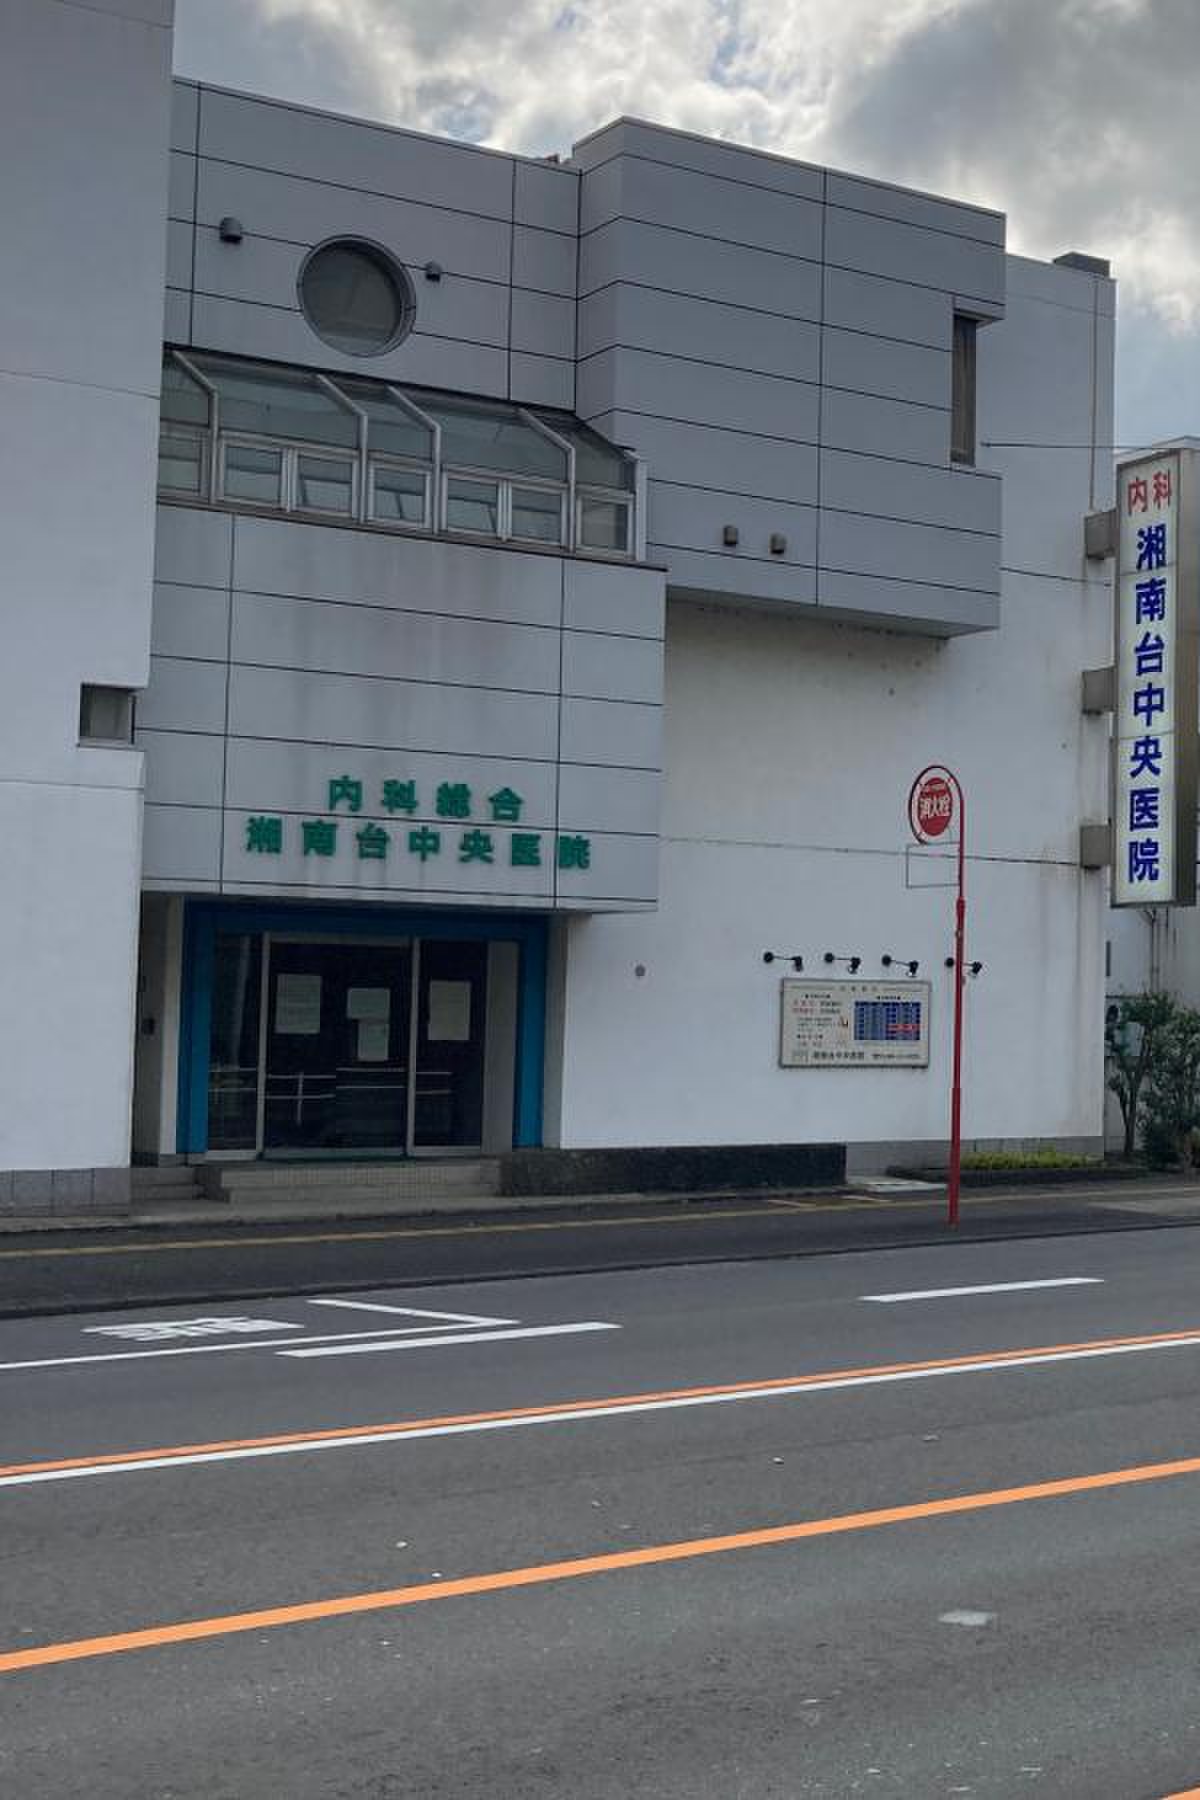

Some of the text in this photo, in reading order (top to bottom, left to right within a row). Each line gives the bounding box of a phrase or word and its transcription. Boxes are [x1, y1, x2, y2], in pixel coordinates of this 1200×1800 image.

[1128, 469, 1171, 516] 内科
[1128, 523, 1167, 884] 湘南台中央医院
[328, 775, 524, 822] 内科総合
[245, 815, 592, 870] 湘南台中央医院
